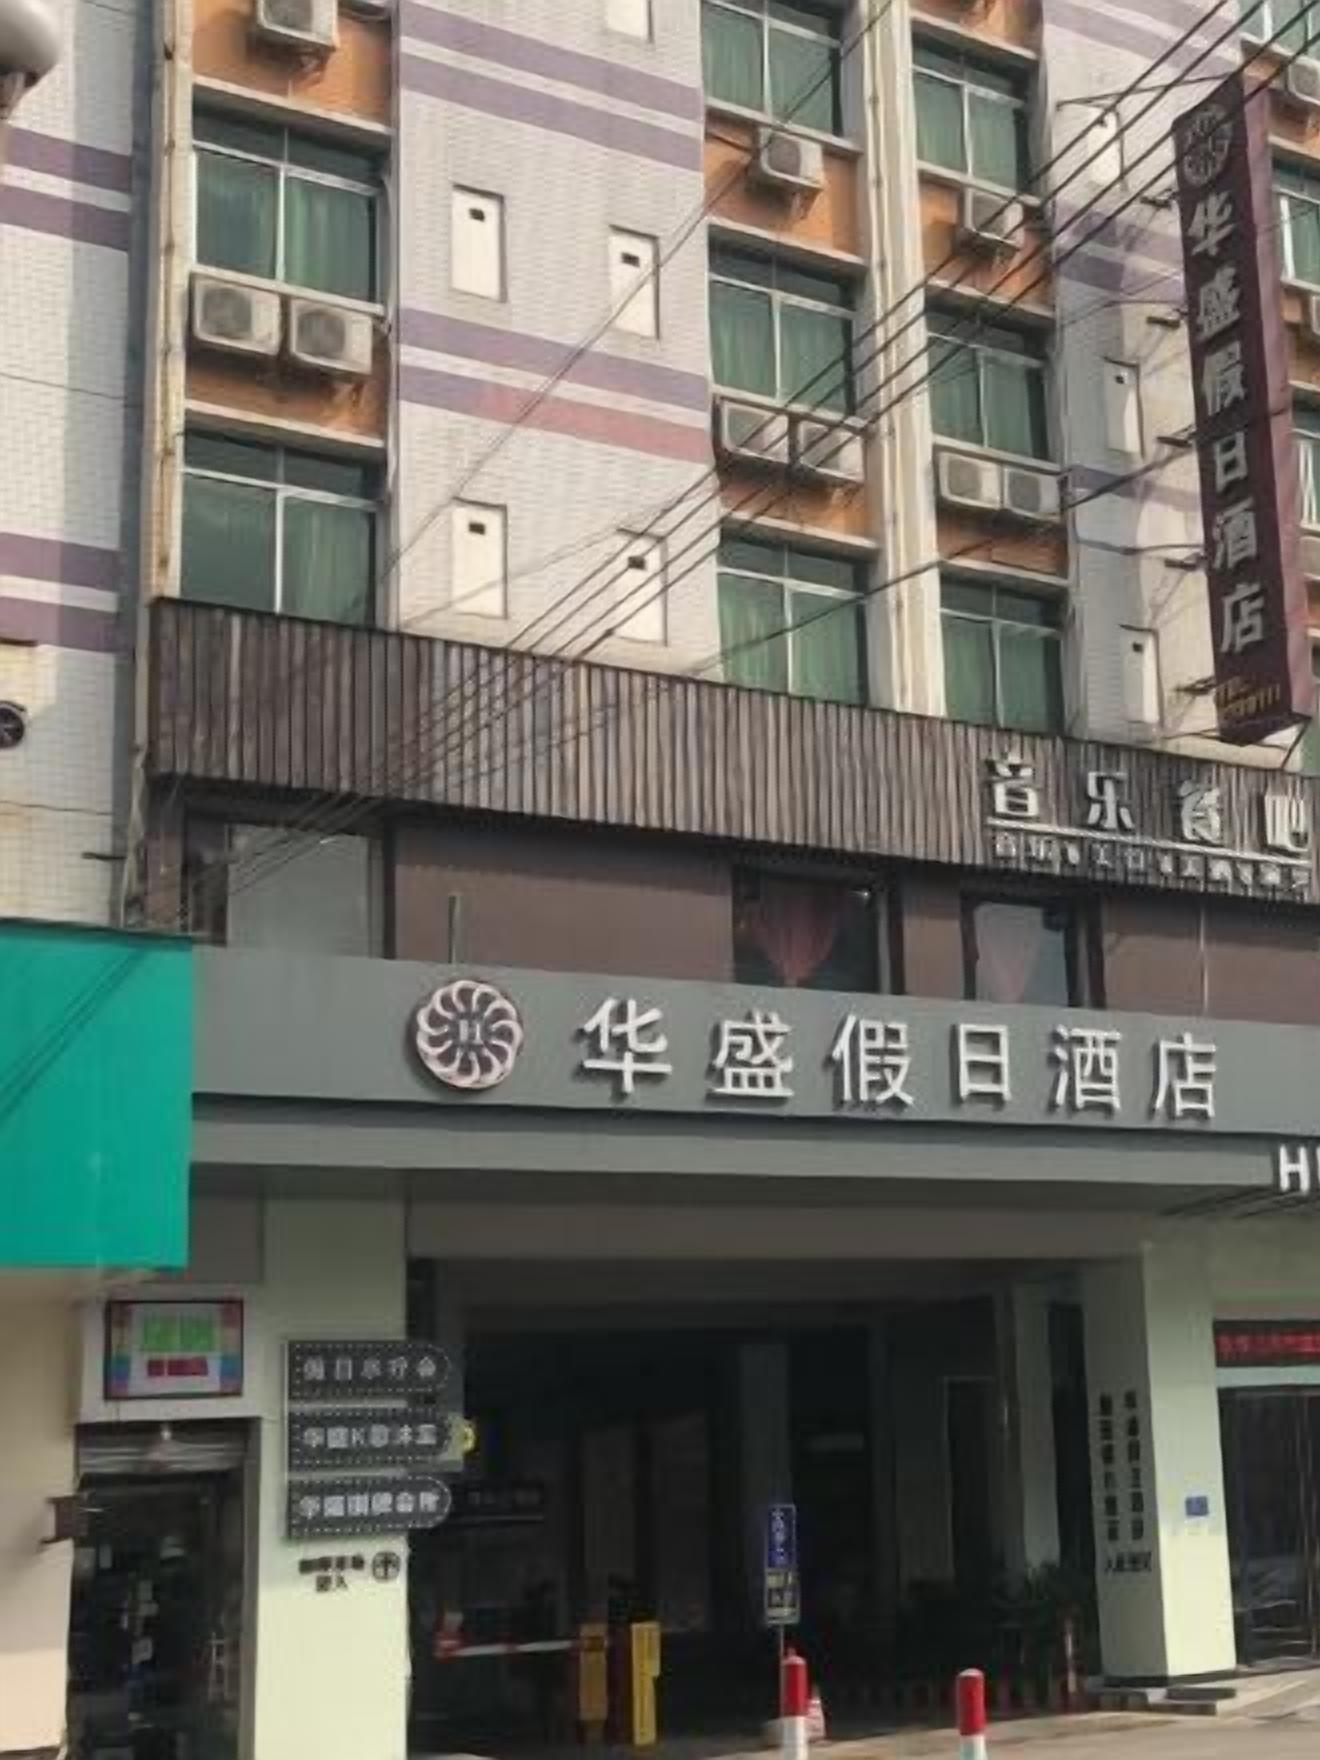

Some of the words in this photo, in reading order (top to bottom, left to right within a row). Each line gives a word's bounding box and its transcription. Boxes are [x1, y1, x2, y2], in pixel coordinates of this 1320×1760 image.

[1187, 193, 1266, 655] 华盛假日酒店
[581, 997, 1218, 1118] 华盛假日酒店
